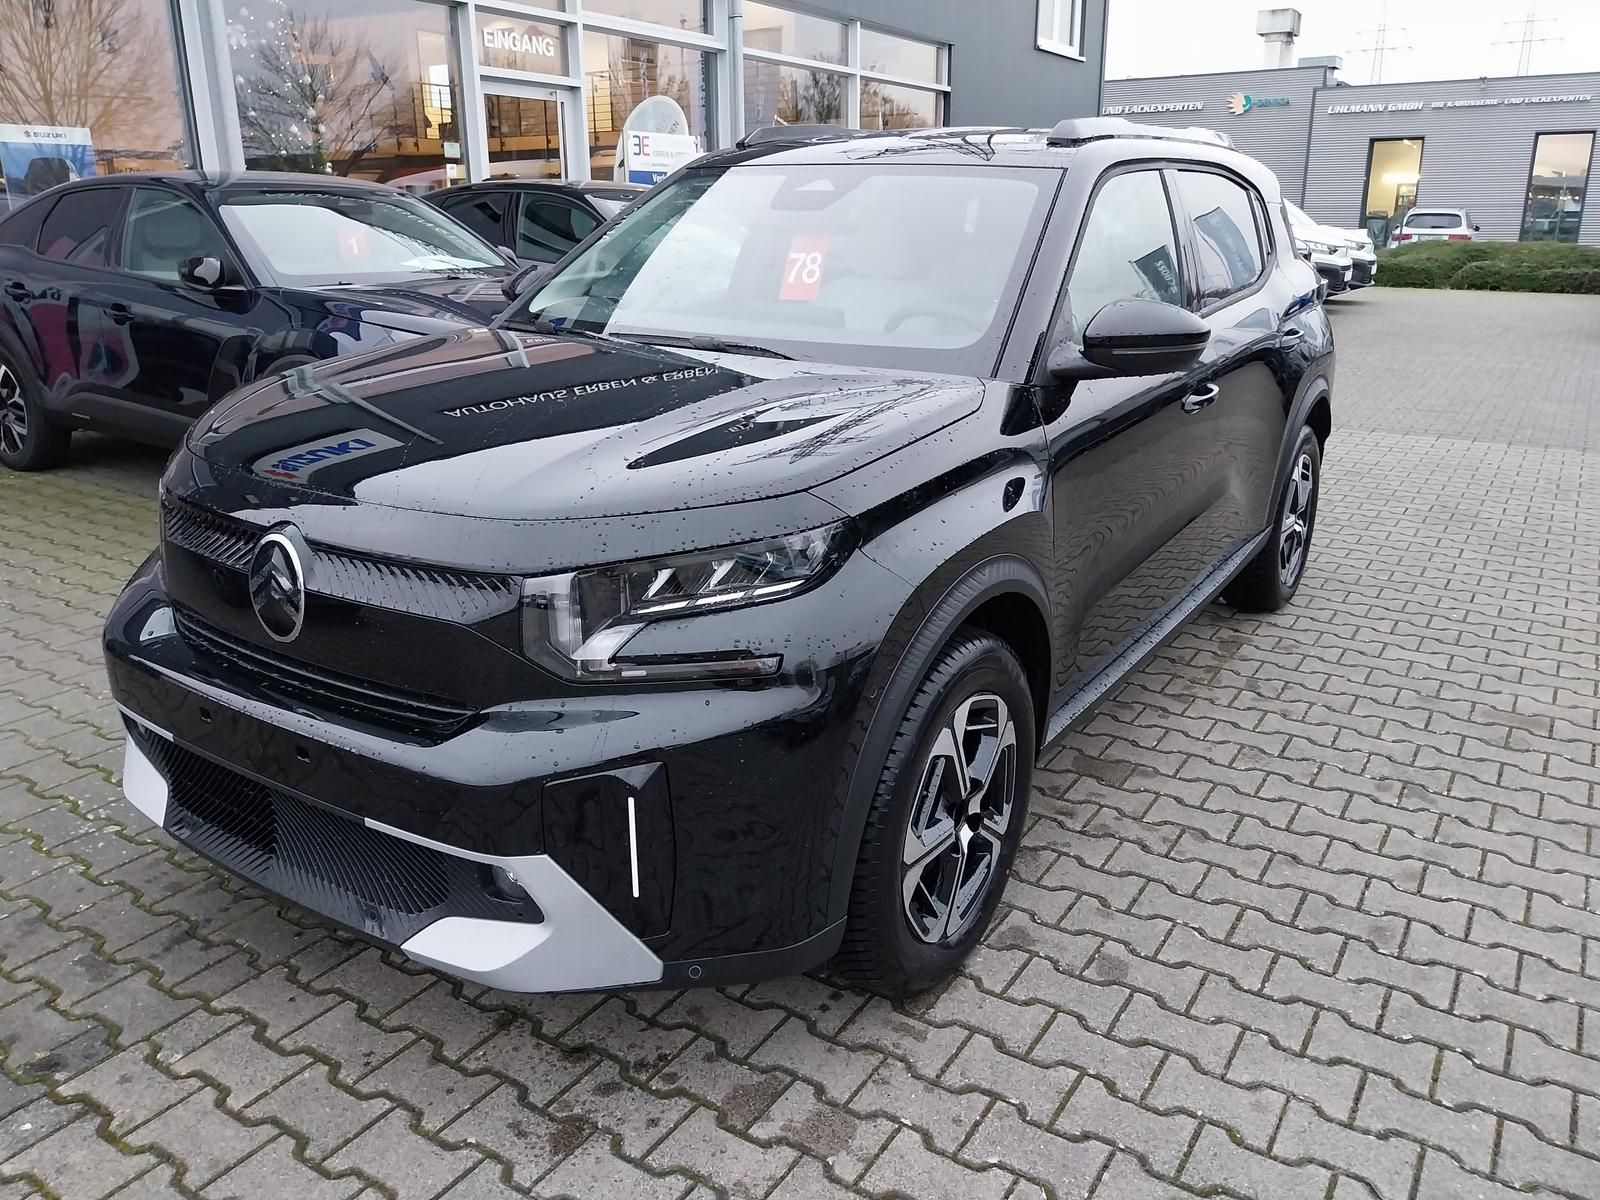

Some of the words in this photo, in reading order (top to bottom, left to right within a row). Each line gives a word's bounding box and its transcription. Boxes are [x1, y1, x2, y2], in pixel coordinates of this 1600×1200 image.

[483, 28, 554, 57] EINGANG
[1102, 106, 1122, 115] UND
[1123, 101, 1204, 114] LACKEXPERTEN
[1327, 104, 1385, 114] UHLMANN
[1387, 102, 1424, 111] GMBH
[33, 131, 67, 139] SUZUKI
[348, 237, 359, 255] 1
[788, 252, 823, 284] 78
